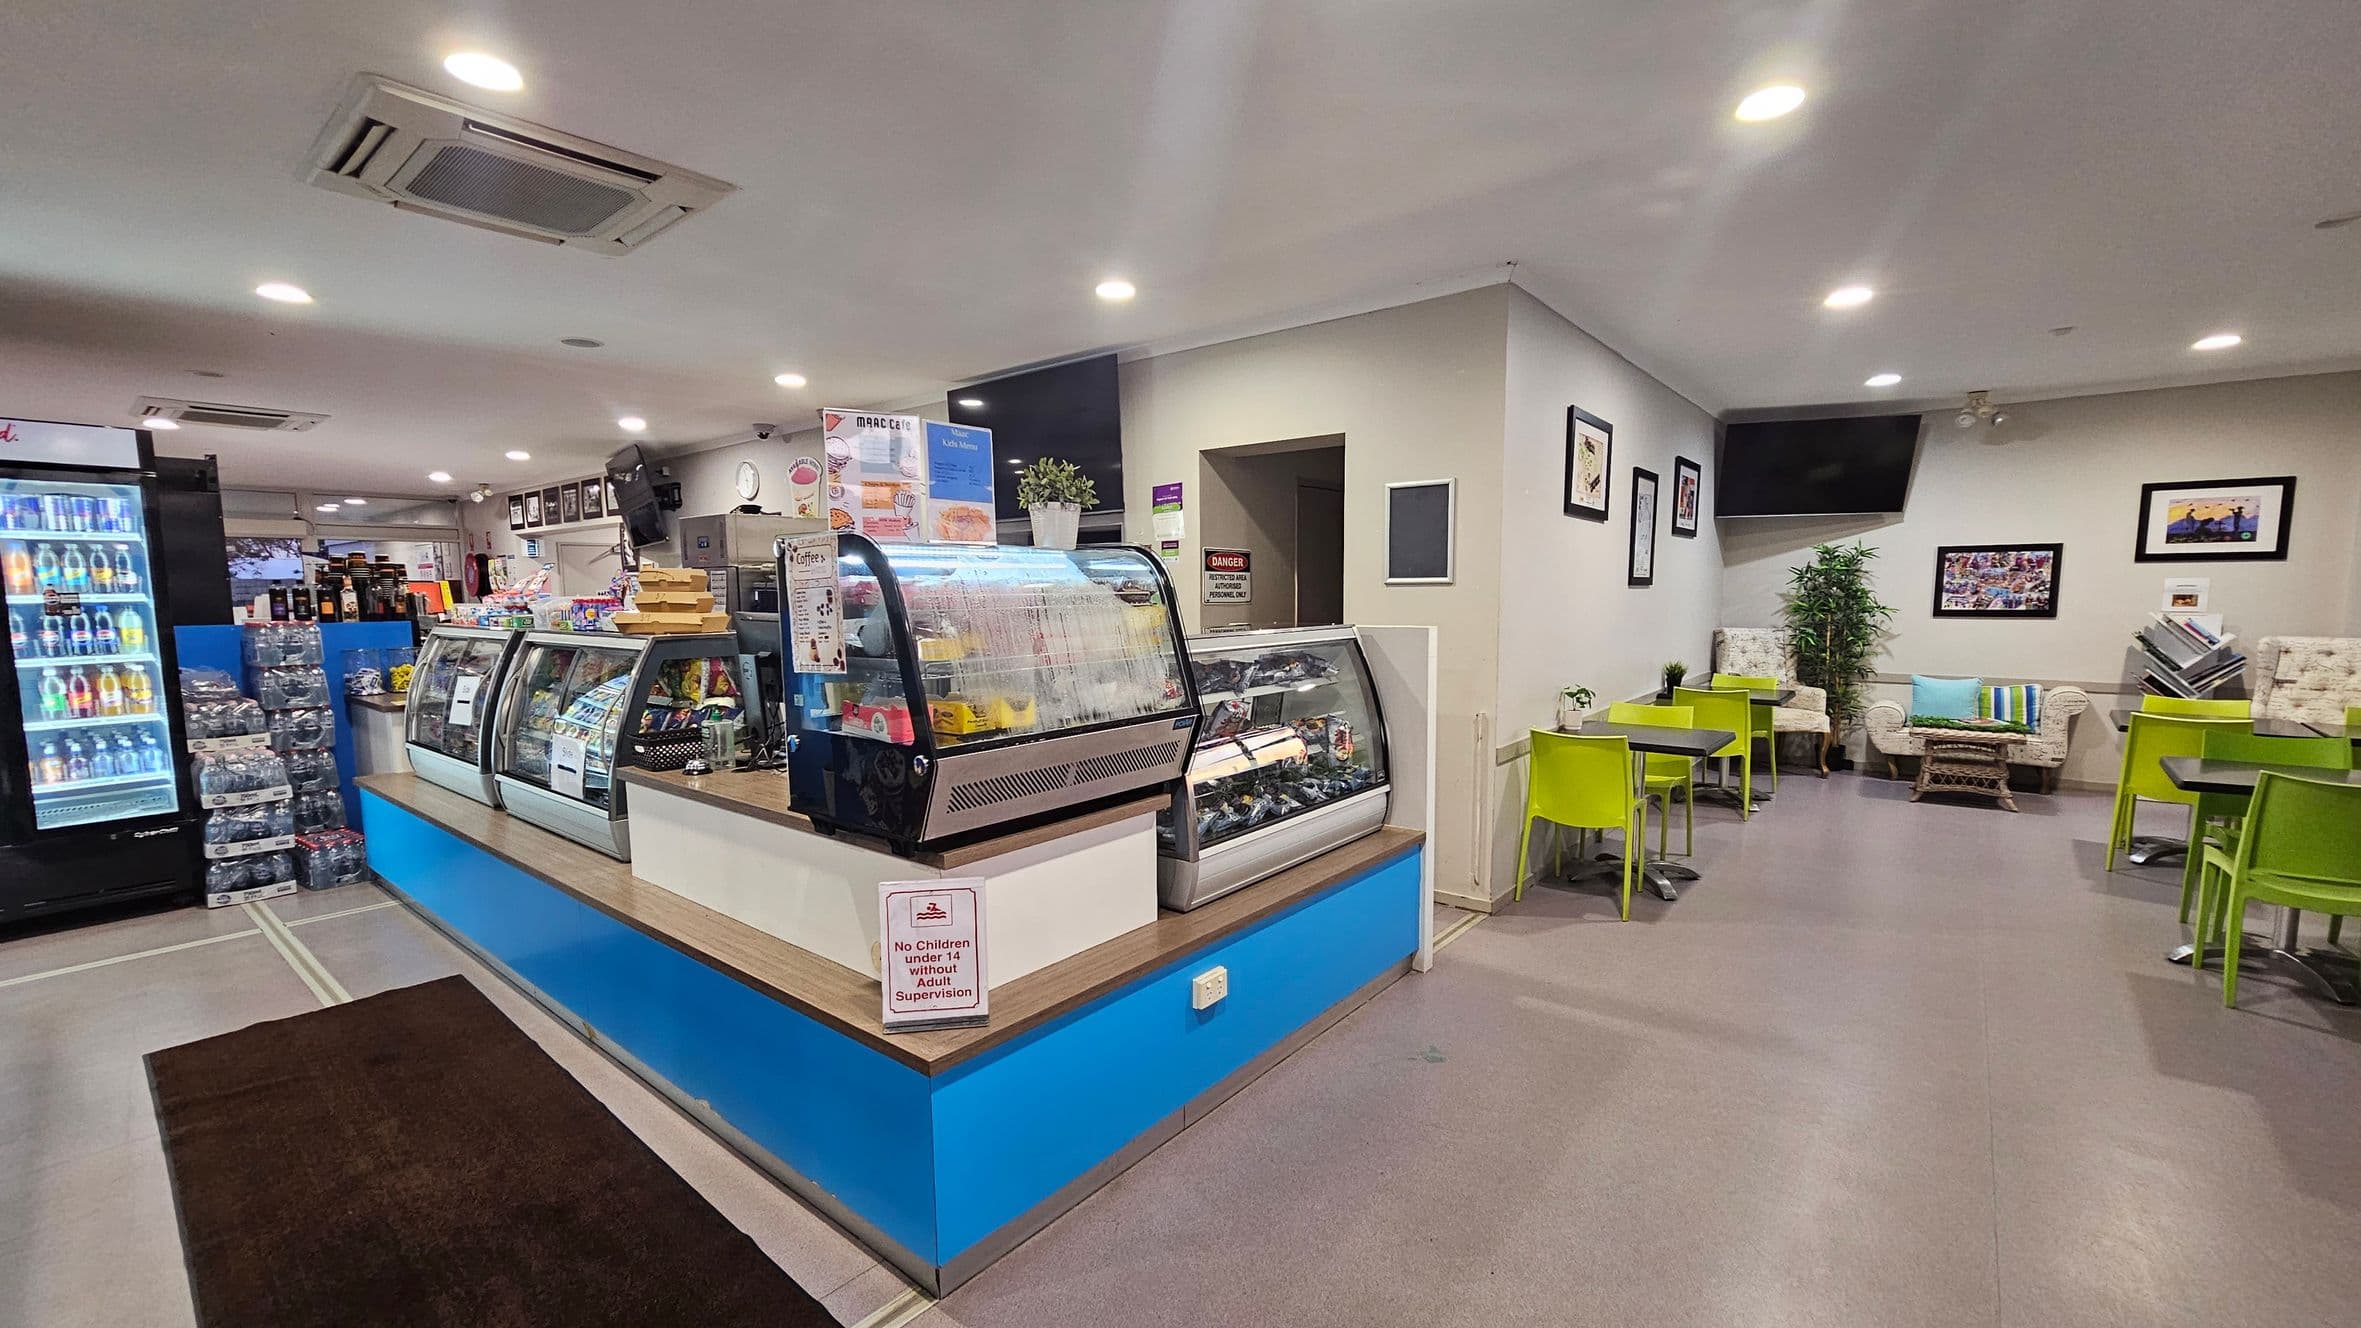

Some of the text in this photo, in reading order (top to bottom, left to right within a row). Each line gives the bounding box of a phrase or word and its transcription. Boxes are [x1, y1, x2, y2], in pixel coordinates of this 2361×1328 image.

[857, 416, 911, 431] MAAC Cafe
[942, 439, 978, 451] Kids Menu
[1212, 557, 1244, 567] DANGER
[894, 939, 970, 952] No Children
[905, 951, 961, 964] under 14
[909, 965, 957, 975] without
[917, 976, 951, 988] Adult
[896, 988, 972, 1002] Supervision
